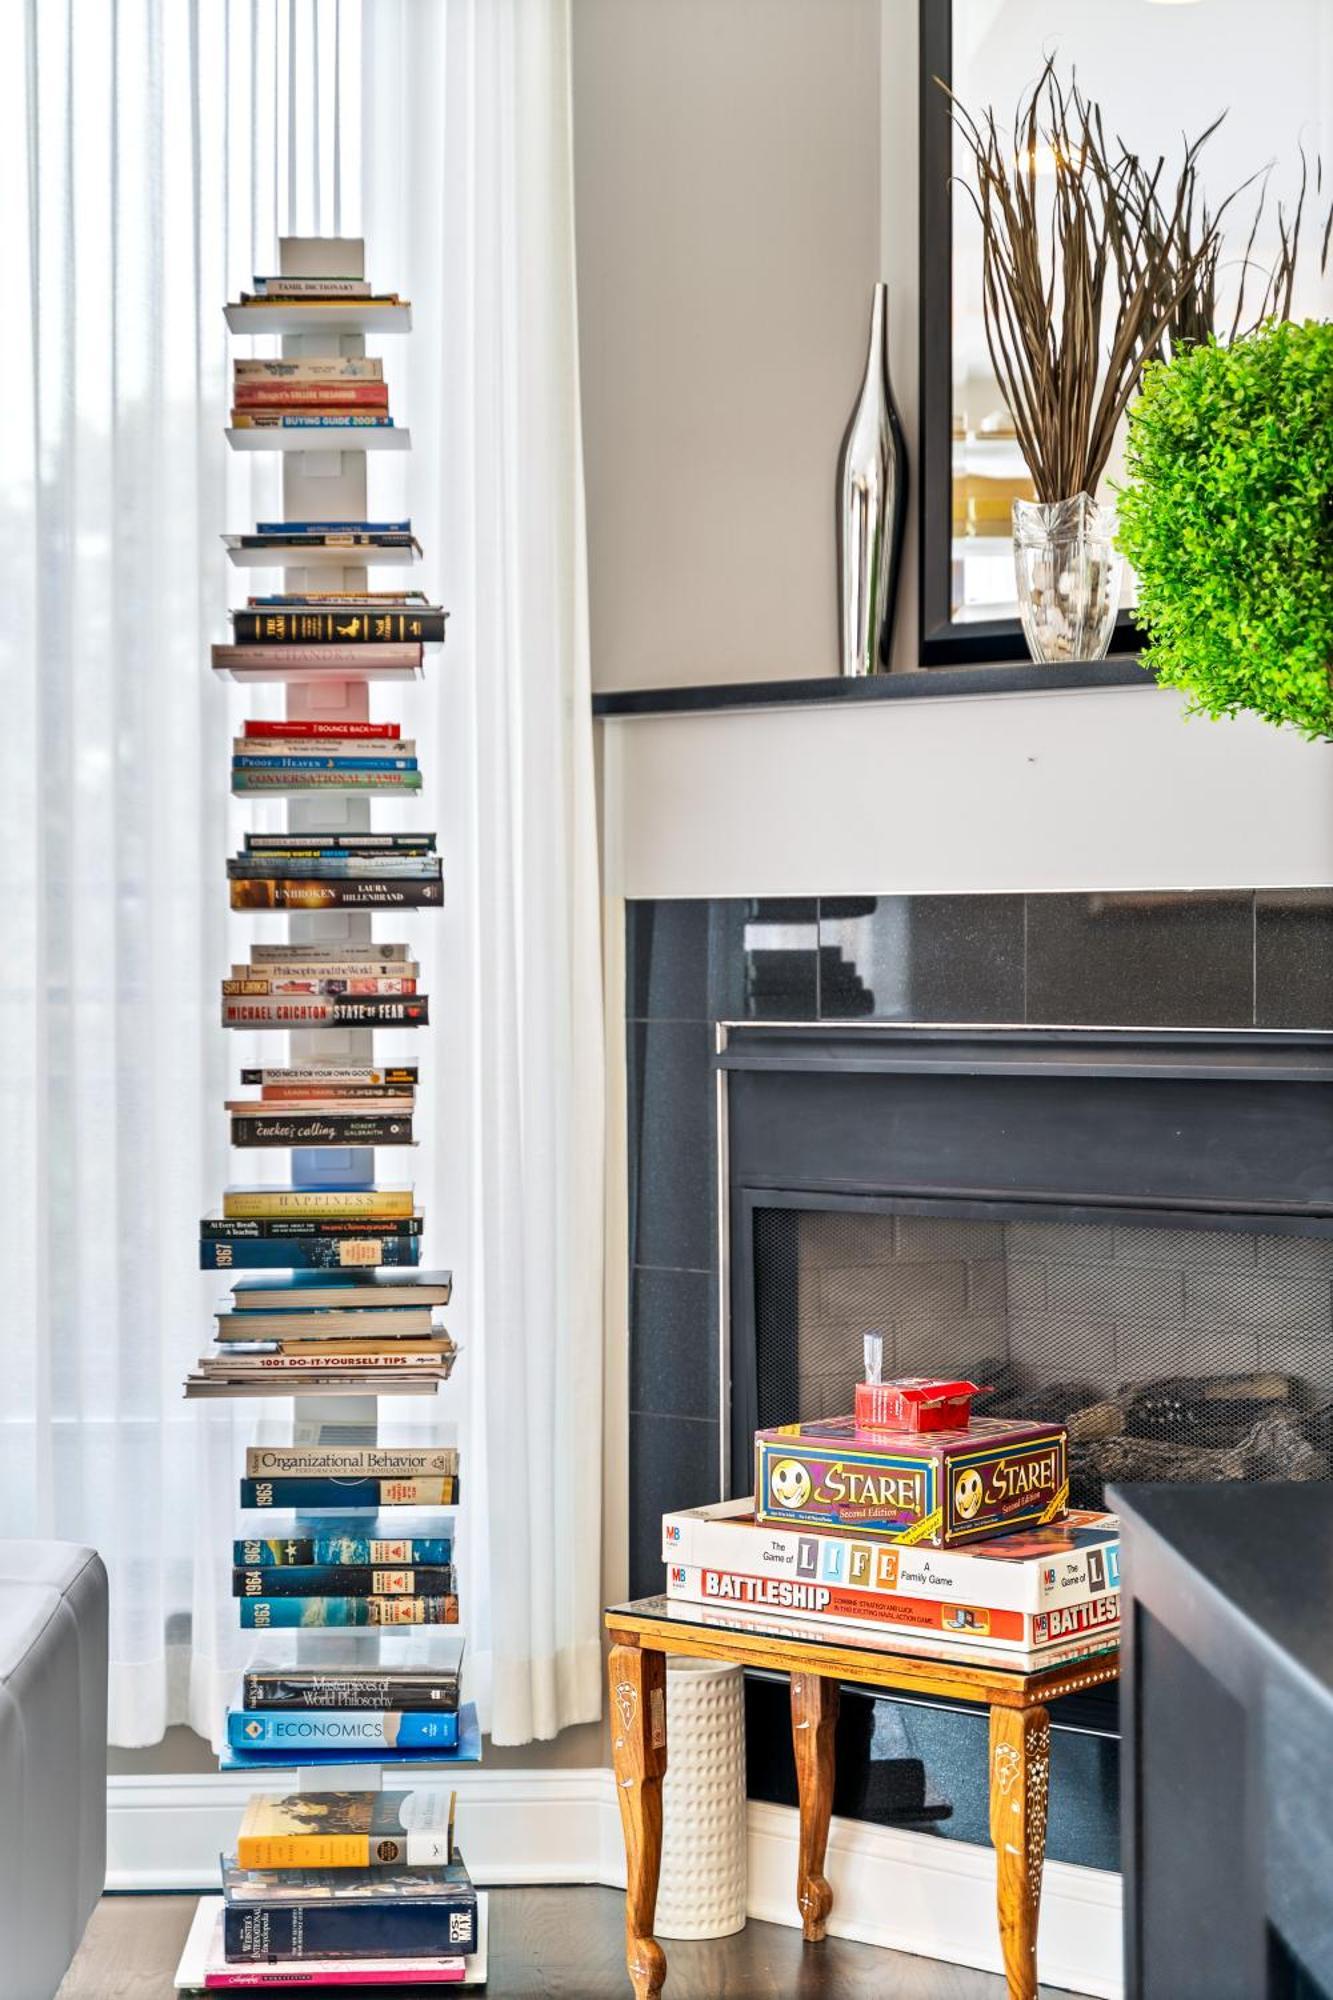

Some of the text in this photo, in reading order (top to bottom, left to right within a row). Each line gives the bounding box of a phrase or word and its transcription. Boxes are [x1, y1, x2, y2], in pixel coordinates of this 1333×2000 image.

[305, 282, 353, 290] DICTIONARY
[284, 415, 321, 426] BUYING
[322, 415, 350, 426] GUIDE
[273, 648, 355, 662] CHANDRA
[317, 724, 348, 733] BOUNCE
[349, 725, 370, 734] BACK
[248, 773, 404, 785] CONVERSATIONAL TAMIL
[275, 889, 336, 899] UNBROKEN
[357, 884, 388, 892] LAURA
[342, 892, 404, 901] HILLENBRAND
[227, 1006, 327, 1020] MICHAEL CRICHTON
[333, 1005, 365, 1019] STATE
[379, 1005, 405, 1019] FEAR
[266, 1070, 282, 1078] TOO
[300, 1069, 313, 1077] FOR
[314, 1069, 333, 1077] YOUR
[351, 1069, 374, 1077] GOOD
[279, 1196, 374, 1206] HAPPINESS
[232, 1229, 259, 1237] Teaching
[215, 1243, 233, 1267] 1967
[289, 1358, 379, 1366] DO-IT-YOURSELF
[383, 1357, 408, 1365] TIPS
[262, 1452, 364, 1471] Organizational
[367, 1451, 427, 1468] Behavior
[984, 1451, 1056, 1504] STARE!
[256, 1483, 273, 1507] 1965
[814, 1462, 922, 1515] STARE!
[1002, 1491, 1041, 1514] Second Edition
[839, 1507, 866, 1519] Second
[868, 1507, 897, 1518] Edition
[666, 1526, 681, 1541] MB
[244, 1540, 261, 1565] 1962
[771, 1541, 786, 1551] The
[763, 1543, 897, 1581] Game of LIFE
[923, 1562, 930, 1571] A
[1066, 1564, 1078, 1574] The
[672, 1567, 686, 1582] MB
[901, 1570, 953, 1587] Family Game
[1044, 1568, 1056, 1585] MB
[1060, 1577, 1080, 1588] Game
[1079, 1573, 1086, 1584] of
[245, 1570, 262, 1597] 1964
[705, 1570, 831, 1612] BATTLESHIP
[859, 1600, 886, 1610] STRATEGY
[898, 1605, 913, 1614] LUCK
[254, 1603, 271, 1628] 1963
[853, 1607, 877, 1617] EXCITING
[879, 1610, 895, 1618] NAVAL
[895, 1613, 916, 1622] ACTION
[917, 1616, 934, 1625] GAME
[1036, 1616, 1048, 1632] MB
[312, 1676, 392, 1692] Masterpieces of
[303, 1691, 394, 1708] World Philosophy
[275, 1723, 383, 1738] ECONOMICS
[242, 1915, 253, 1952] WEBSTER'S
[251, 1907, 261, 1959] INTERNATIONAL
[260, 1912, 270, 1953] Encyclopedia
